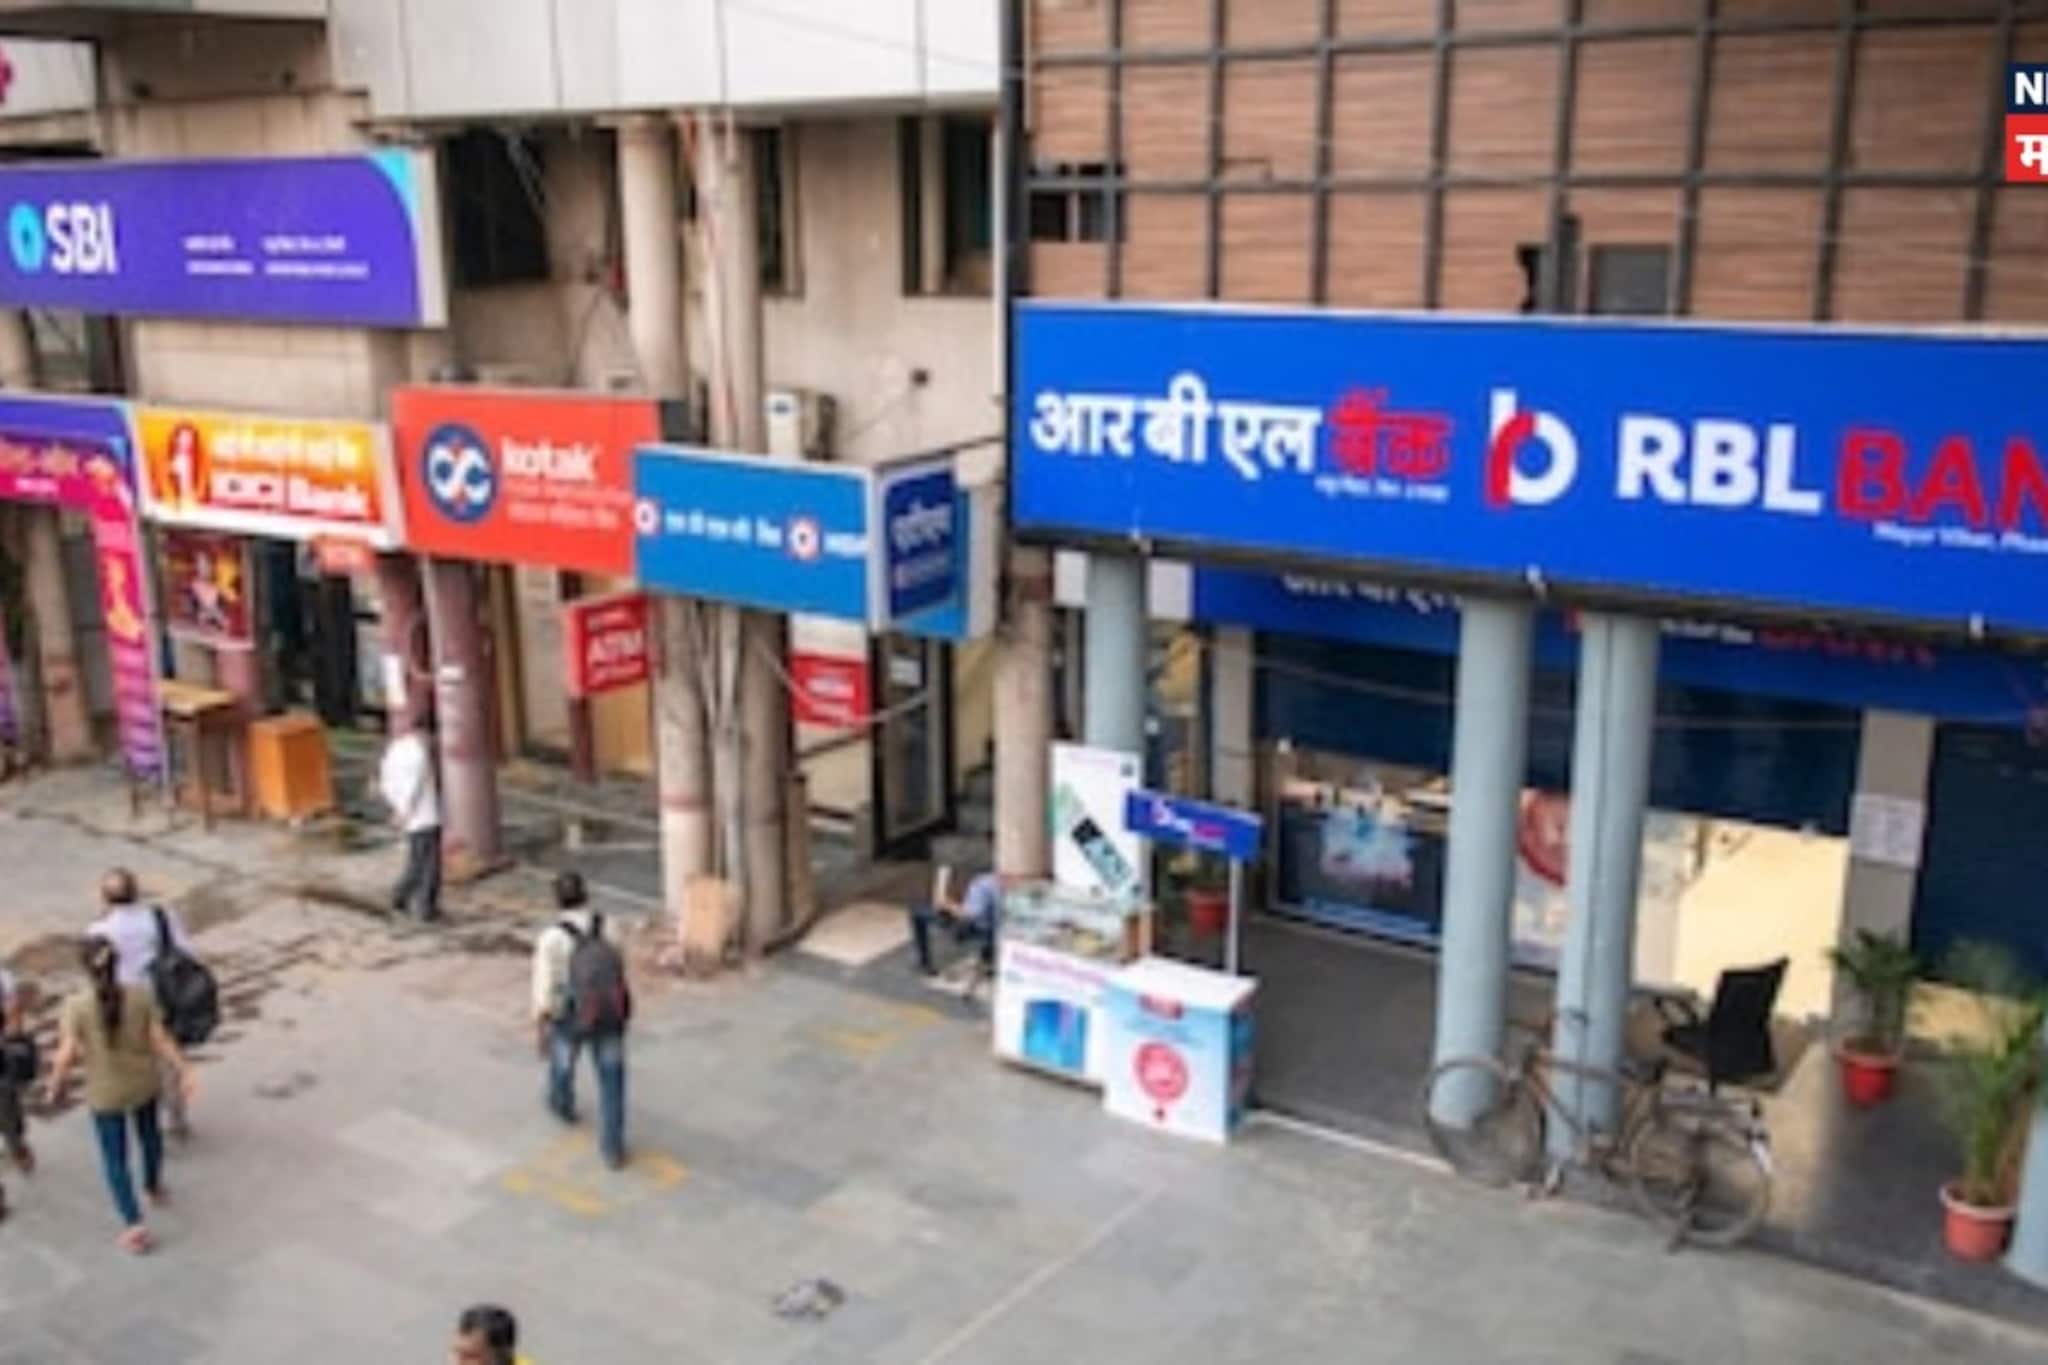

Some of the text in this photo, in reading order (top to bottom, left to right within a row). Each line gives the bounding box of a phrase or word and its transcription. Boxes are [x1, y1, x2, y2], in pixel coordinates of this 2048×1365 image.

[46, 202, 118, 275] SBI
[1328, 385, 1453, 479] बैंक
[1616, 414, 1822, 515] RBL
